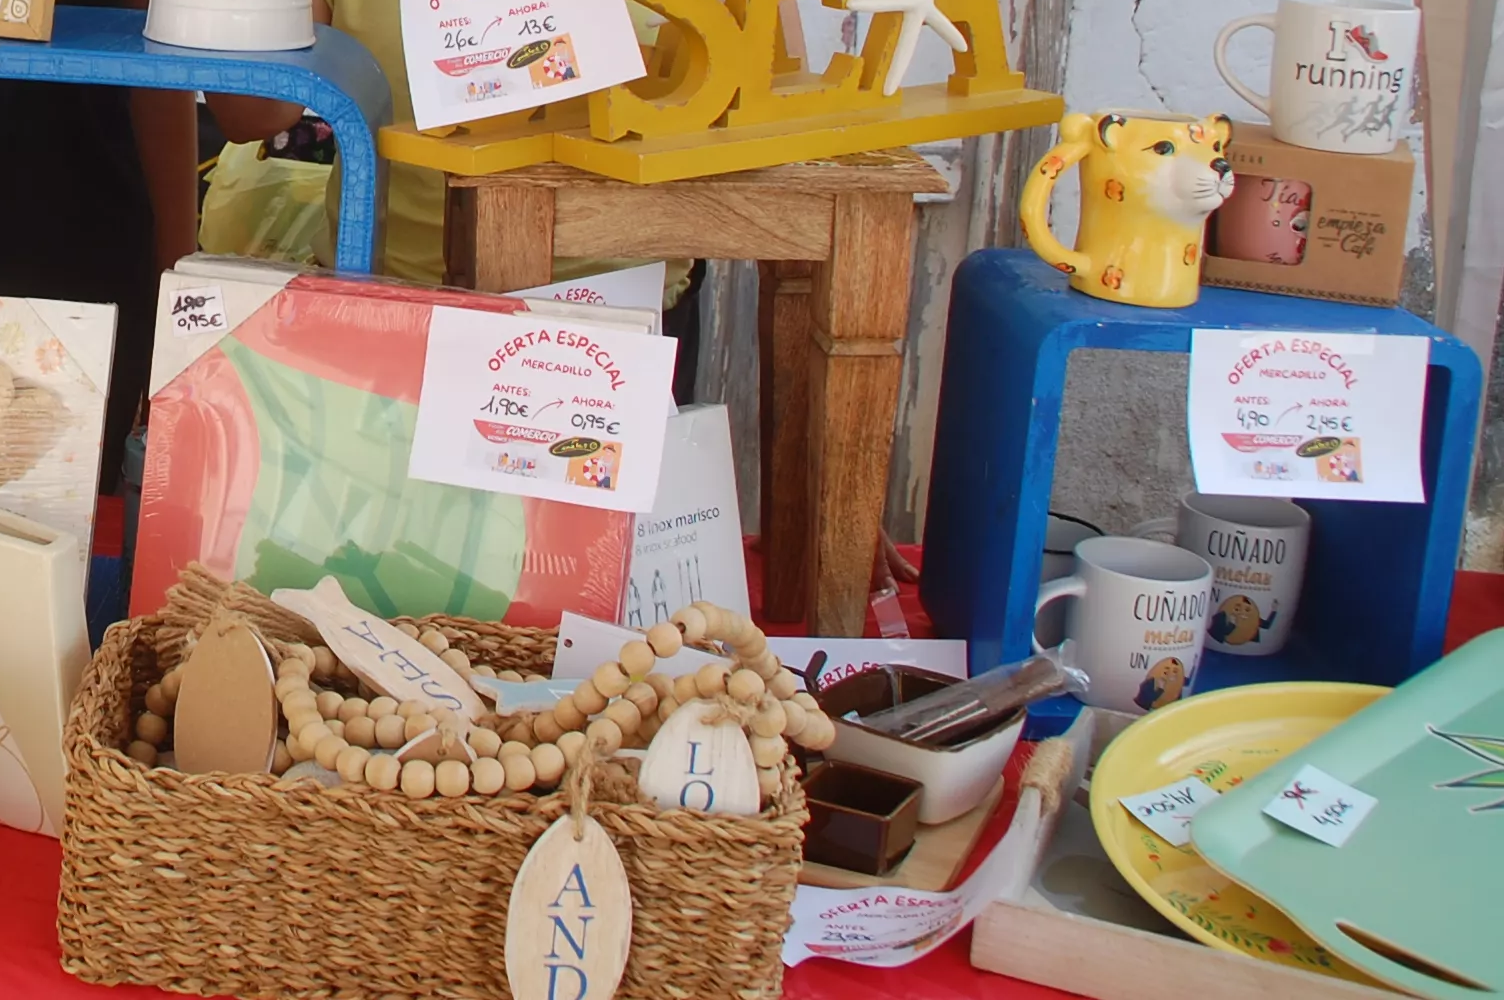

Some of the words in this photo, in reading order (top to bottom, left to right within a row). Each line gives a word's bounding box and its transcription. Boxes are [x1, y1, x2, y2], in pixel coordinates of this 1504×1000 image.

[438, 17, 472, 29] ANTES:
[508, 1, 550, 17] AHORA:
[444, 29, 479, 51] 26€
[518, 15, 557, 36] 13€
[463, 48, 510, 67] COMERCIO
[1296, 62, 1404, 94] running
[177, 313, 223, 331] 0,95€
[488, 329, 551, 372] OFERTA
[556, 330, 626, 391] ESPECIAL
[521, 358, 592, 377] MERCADILLO
[1228, 340, 1286, 385] OFERTA
[1291, 338, 1358, 390] ESPECIAL
[1259, 369, 1327, 380] MERCADILLO
[493, 383, 531, 397] ANTES:
[572, 396, 616, 410] AHORA:
[480, 395, 529, 418] 1,90€
[571, 413, 621, 435] 0,95€
[505, 425, 557, 443] COMERCIO
[648, 518, 674, 535] inox
[675, 507, 721, 528] marisco
[1207, 529, 1287, 566] CUÑADO
[1133, 591, 1207, 623] CUÑADO
[1129, 651, 1150, 670] UN
[817, 662, 857, 692] ERTA
[819, 894, 889, 920] OFERTA
